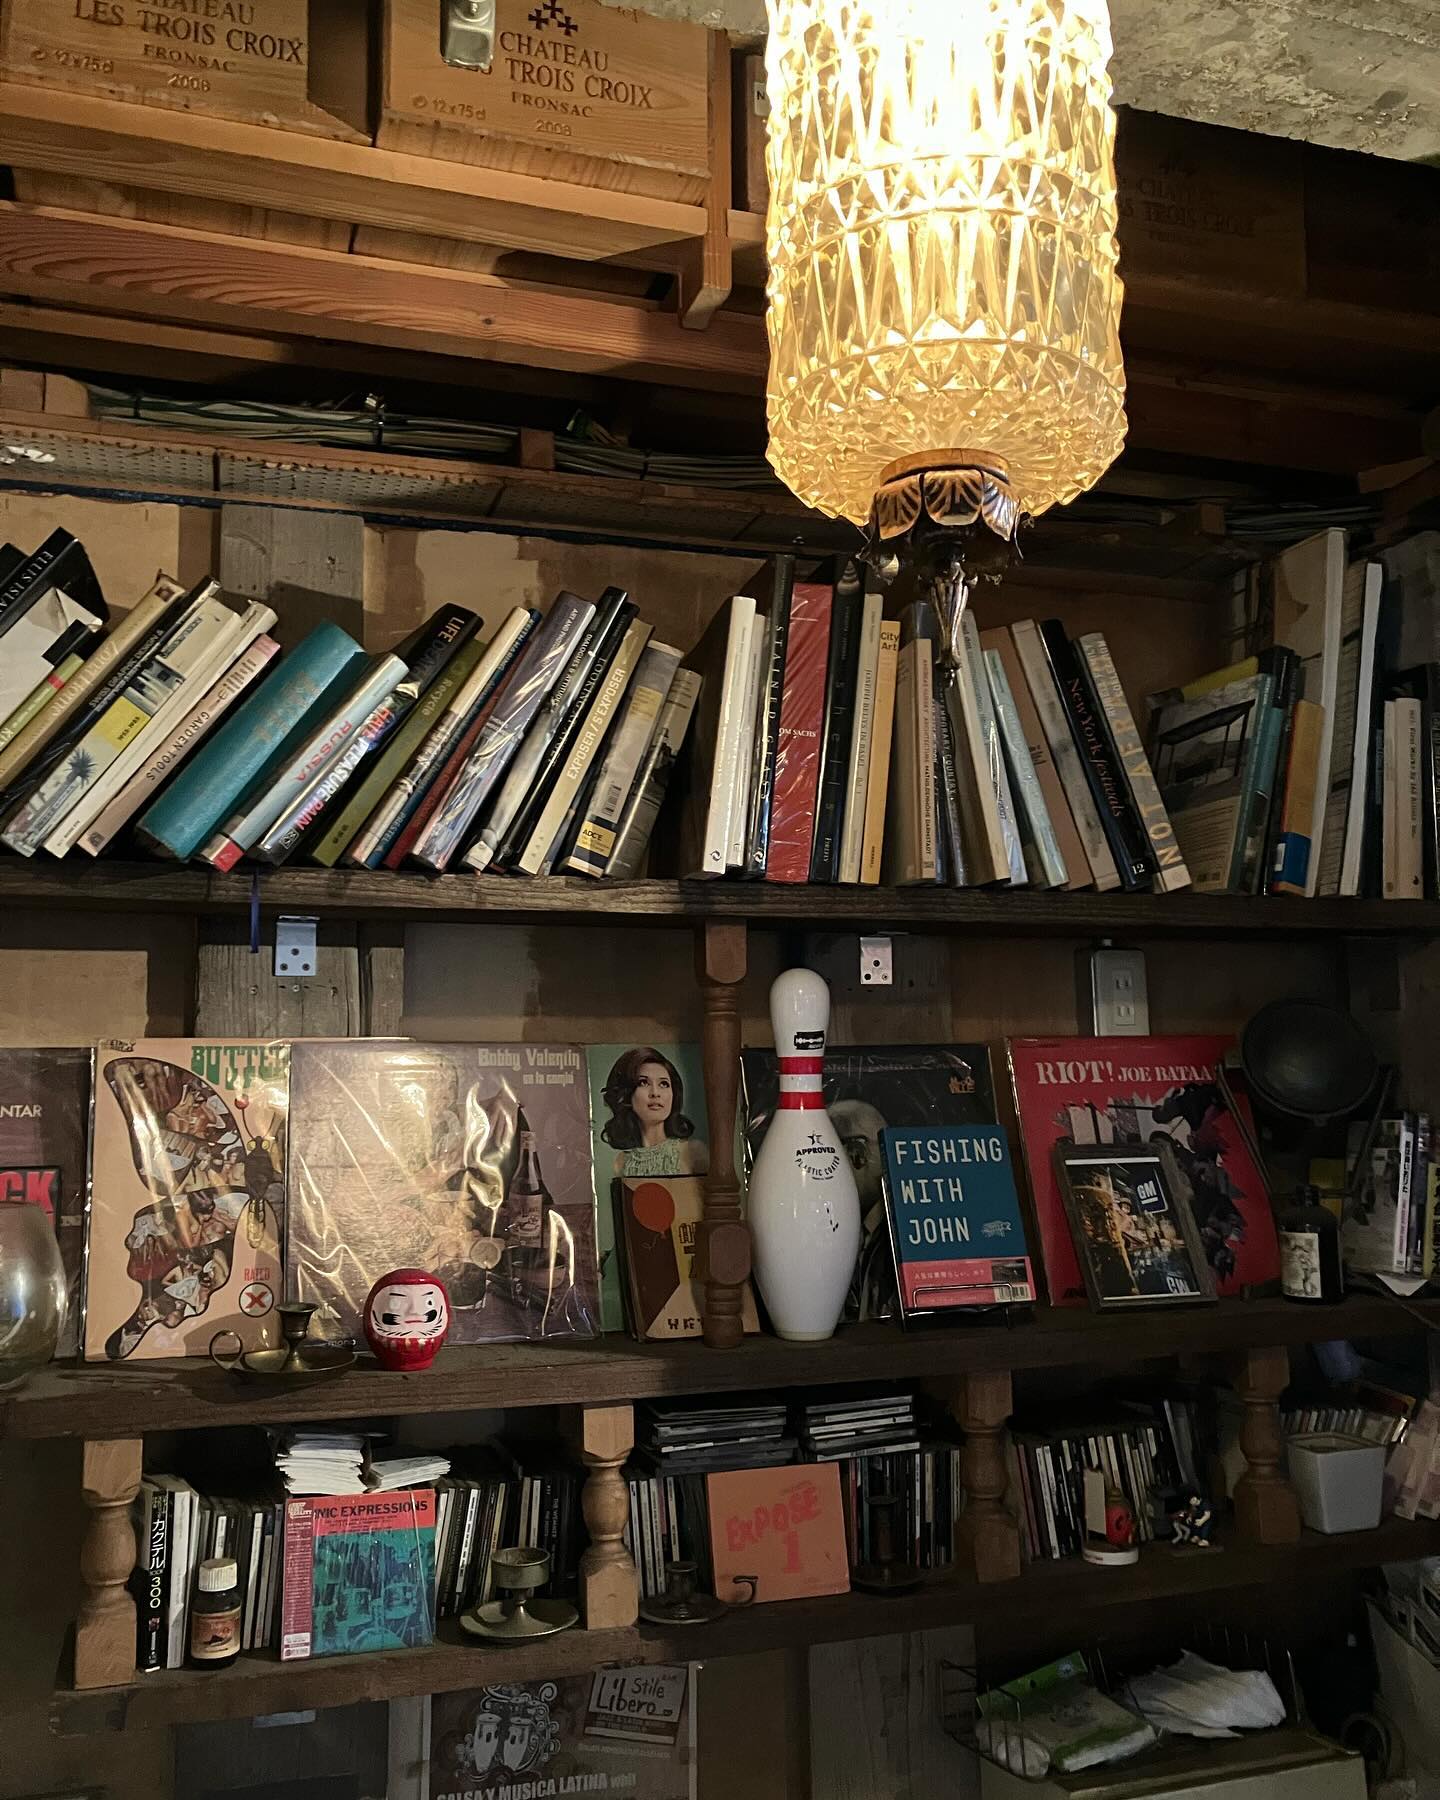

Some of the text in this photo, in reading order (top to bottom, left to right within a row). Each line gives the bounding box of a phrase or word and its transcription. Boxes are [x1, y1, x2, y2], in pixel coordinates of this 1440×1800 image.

[138, 10, 216, 46] TROIS
[226, 28, 305, 66] CROIX
[500, 31, 609, 72] CHATEAU
[143, 44, 238, 73] FRONSAC
[504, 57, 575, 93] TROIS
[584, 75, 653, 110] CROIX
[511, 91, 594, 118] FRONSAC
[21, 550, 54, 584] ELLIS
[438, 616, 466, 644] LIFE
[880, 631, 900, 651] City Art
[570, 633, 594, 668] DIALOGUES
[768, 624, 785, 720] STAINED
[422, 678, 454, 717] Recycle
[361, 706, 394, 739] HATE
[566, 730, 597, 780] EXPOSER
[596, 667, 627, 725] S'EXPOSER
[793, 729, 817, 738] SACHS
[145, 711, 210, 782] GARDEN TOOLS
[297, 721, 353, 783] RUSSIA
[1066, 678, 1127, 818] New York festivals
[311, 736, 370, 802] PLEASURE
[294, 799, 325, 831] PAIN
[1131, 863, 1145, 876] 12
[478, 1047, 521, 1071] Bobby
[1035, 1061, 1113, 1085] RIOT!
[1118, 1066, 1151, 1083] JOE
[0, 1104, 43, 1118] NTAR
[795, 1146, 836, 1157] APPROVED
[895, 1137, 1003, 1165] FISHING
[901, 1177, 964, 1204] WITH
[1137, 1180, 1157, 1201] GM
[908, 1216, 970, 1245] JOHN
[243, 1267, 271, 1281] RATED
[245, 1291, 268, 1309] X
[340, 1500, 428, 1518] EXPRESSIONS
[149, 1518, 166, 1571] カクテル
[149, 1576, 161, 1609] 300
[631, 1677, 665, 1698] Stile
[500, 1780, 557, 1800] MUSICA
